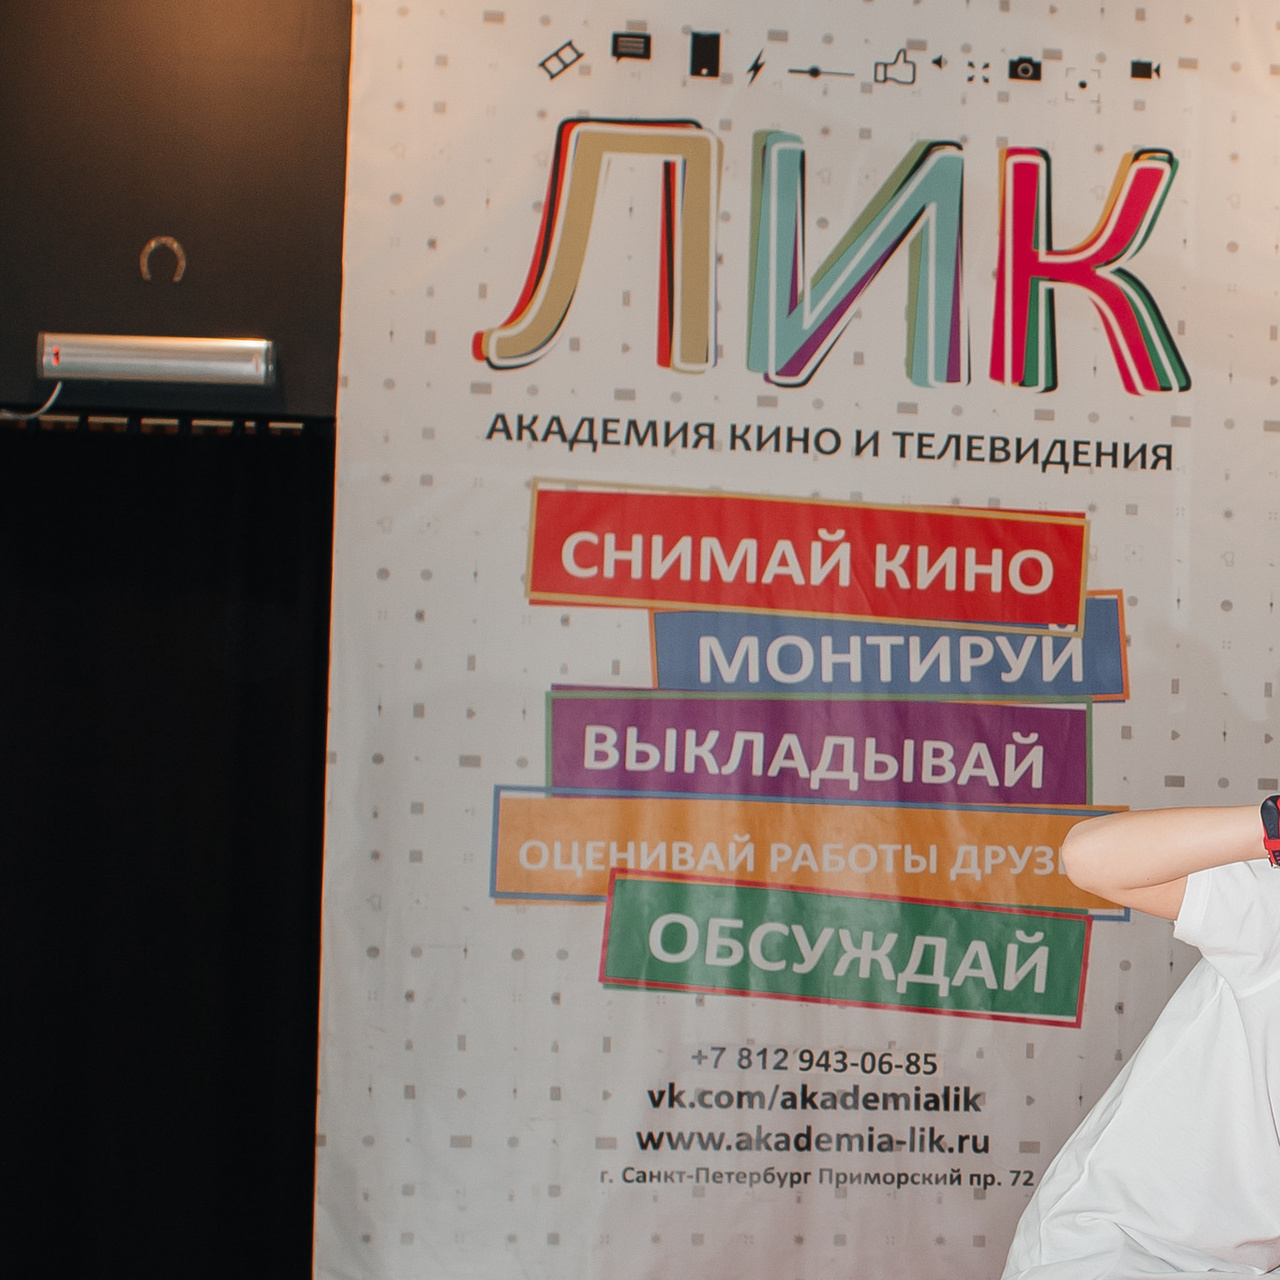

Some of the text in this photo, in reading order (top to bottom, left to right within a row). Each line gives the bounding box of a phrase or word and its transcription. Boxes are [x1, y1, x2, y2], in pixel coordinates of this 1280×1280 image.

[471, 117, 1192, 396] ЛИК
[486, 413, 1174, 474] АКАДЕМИЯ КИНО И ТЕЛЕВИДЕНИЯ
[560, 528, 1055, 596] СНИМАЙ КИНО
[699, 623, 1084, 683] МОНТИРУЙ
[582, 724, 1045, 791] ВЫКЛАДЫВАЙ
[518, 834, 756, 877] ОЦЕНИВАЙ
[770, 842, 938, 874] РАБОТЫ
[647, 912, 1051, 997] ОБСУЖДАЙ
[691, 1046, 938, 1076] +7 812 943-06-85
[647, 1082, 982, 1113] vk.com/akademialik
[635, 1125, 990, 1155] www.akademia-lik.ru
[600, 1166, 1035, 1191] г. Санкт-Петербург Приморский пр. 72
